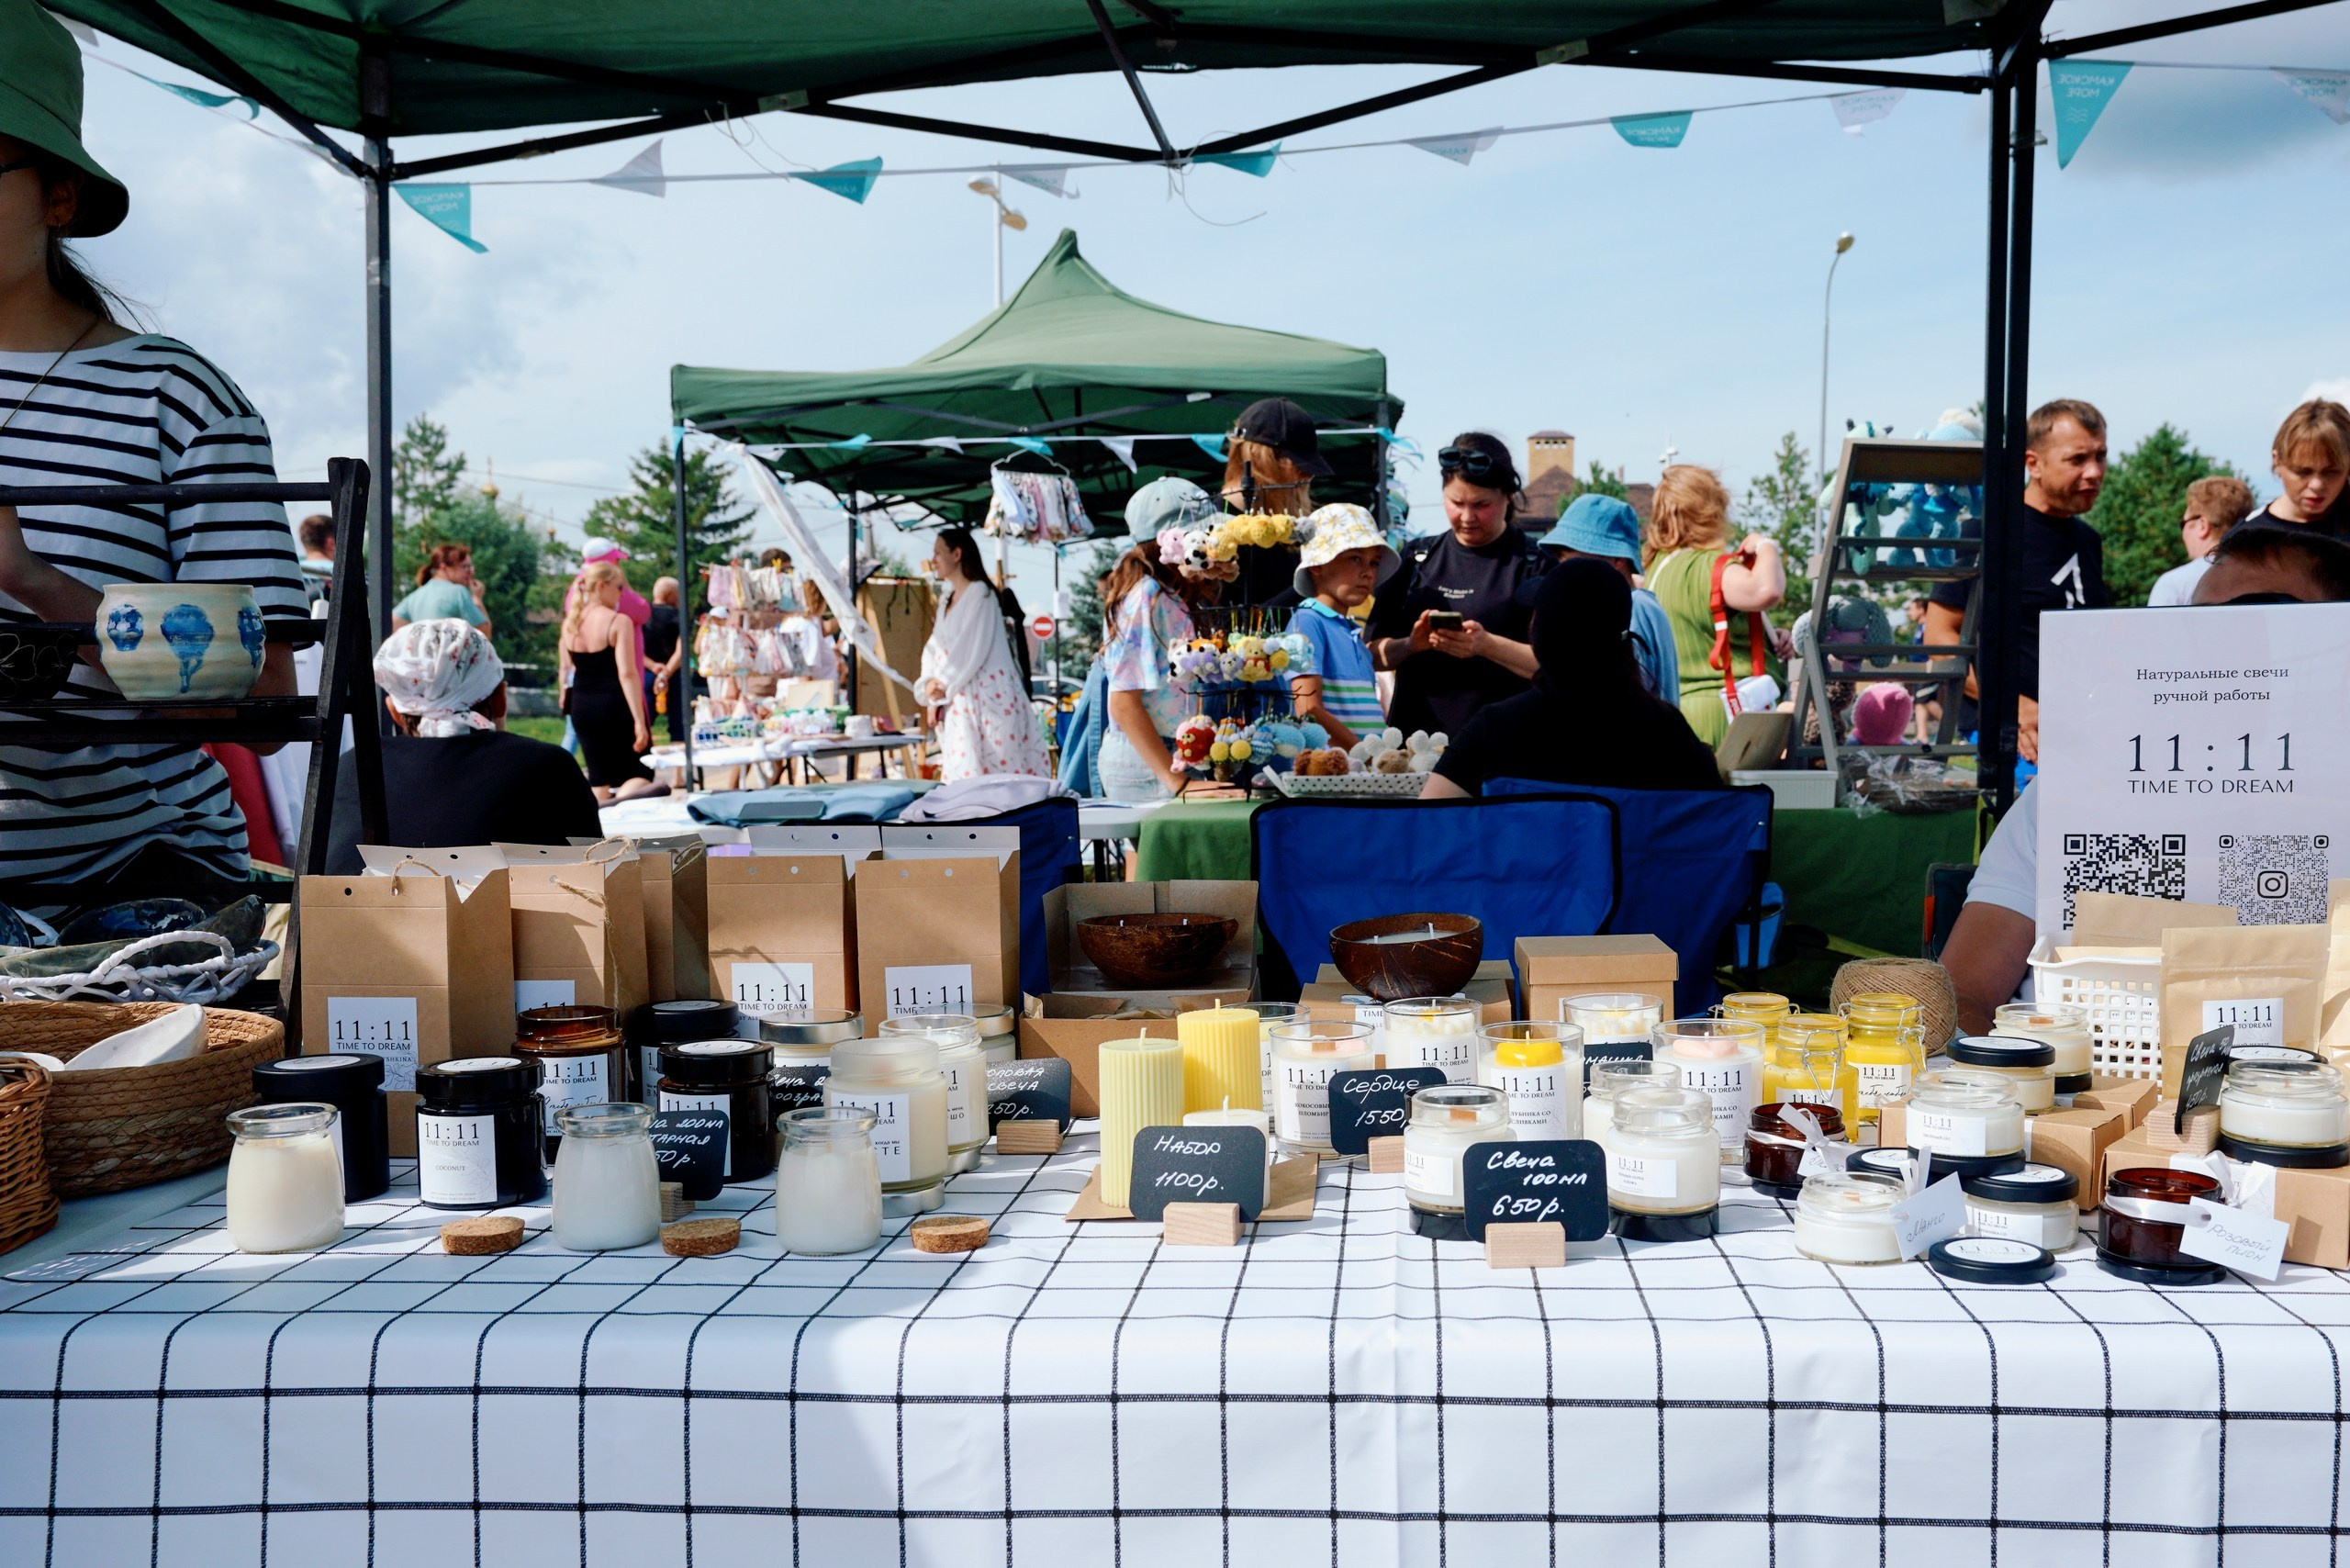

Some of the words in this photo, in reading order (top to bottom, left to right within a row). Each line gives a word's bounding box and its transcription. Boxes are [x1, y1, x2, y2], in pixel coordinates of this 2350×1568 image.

[2137, 668, 2239, 682] Натуральные
[2244, 668, 2289, 678] свечи
[2154, 690, 2208, 704] ручной
[2213, 689, 2270, 703] работы
[2129, 733, 2295, 772] 11:11
[2128, 780, 2177, 793] TIME
[2185, 779, 2213, 793] TO
[2221, 779, 2293, 793] DREAM
[739, 983, 807, 1002] 11:11
[893, 985, 966, 1005] 11:11
[2217, 1005, 2272, 1023] 11:11
[335, 1020, 410, 1040] 11:11
[336, 1042, 359, 1050] TIME
[362, 1042, 375, 1050] TO
[378, 1042, 410, 1050] DREAM
[1421, 1045, 1469, 1061] 11:11
[986, 1067, 1045, 1080] ОЛОВАЯ
[1687, 1070, 1741, 1087] 11:11
[1863, 1067, 1895, 1077] 11:11
[1343, 1074, 1420, 1104] Сердце
[1501, 1075, 1554, 1092] 11:11
[425, 1122, 479, 1139] 11:11
[426, 1138, 440, 1147] TIME
[1487, 1150, 1556, 1170] Свеча
[1978, 1212, 2007, 1226] 11:11
